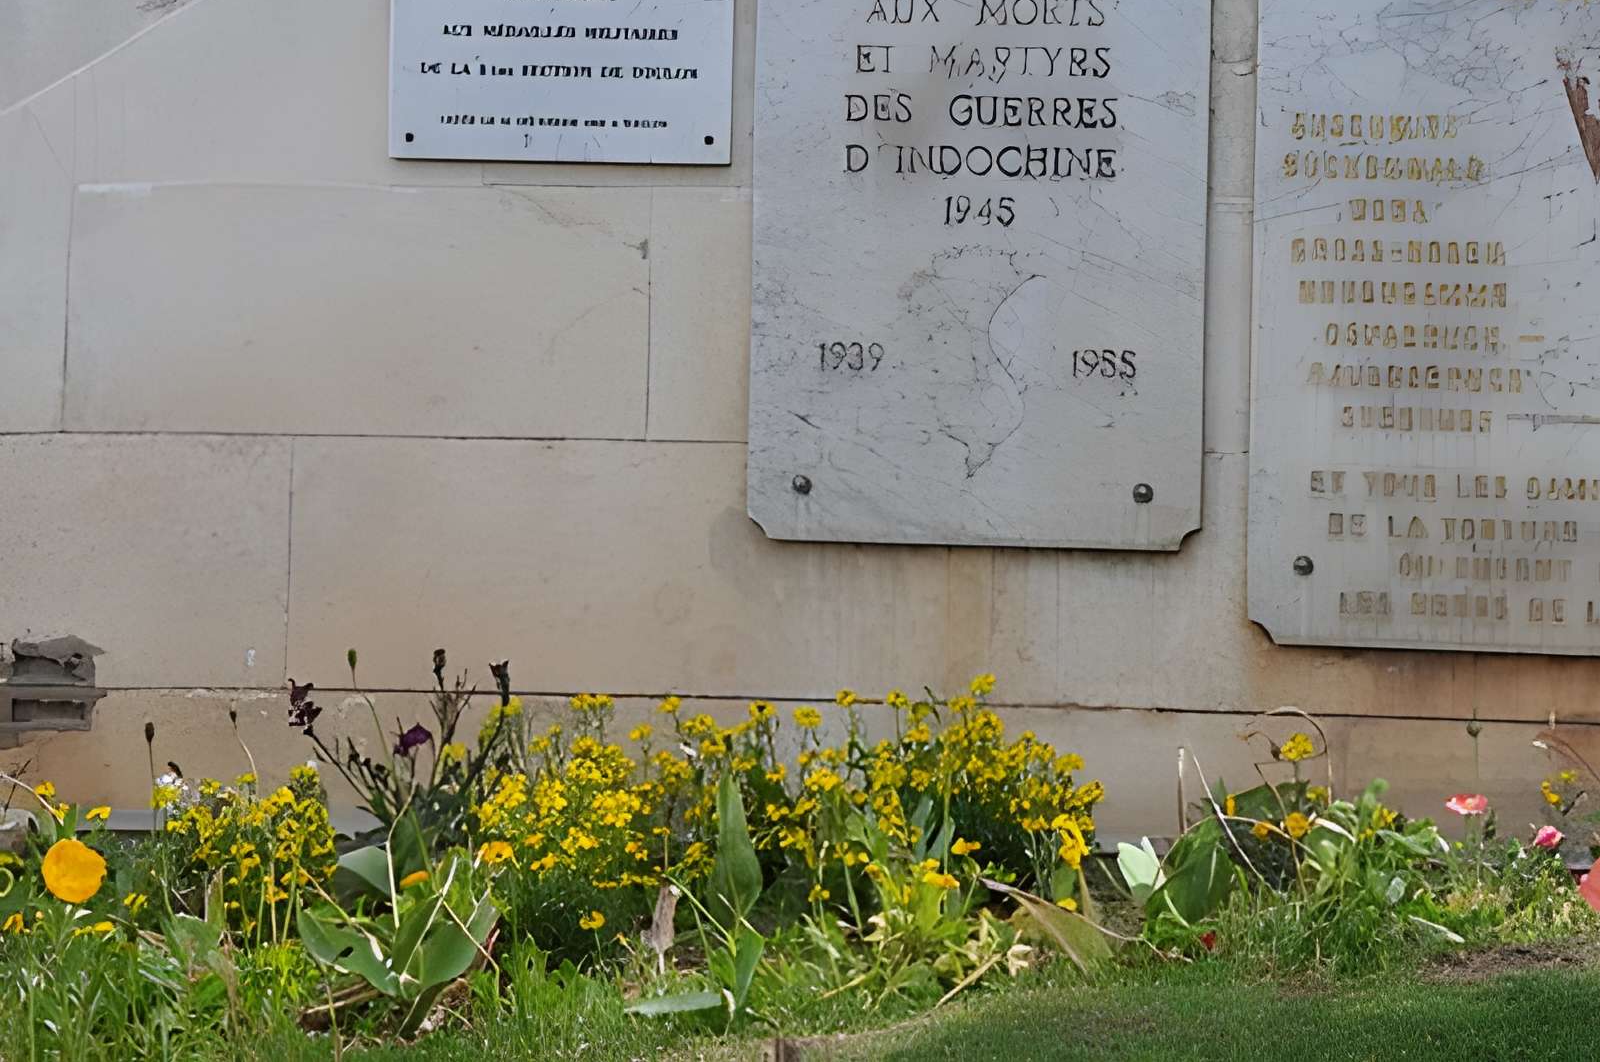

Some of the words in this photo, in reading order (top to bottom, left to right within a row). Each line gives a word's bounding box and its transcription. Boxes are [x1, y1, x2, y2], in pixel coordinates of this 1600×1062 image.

[856, 45, 894, 74] ET
[845, 95, 913, 123] DES
[949, 95, 1118, 129] GUERRES
[943, 195, 1016, 227] 1945
[818, 341, 885, 372] 1939
[1072, 349, 1138, 379] 1955
